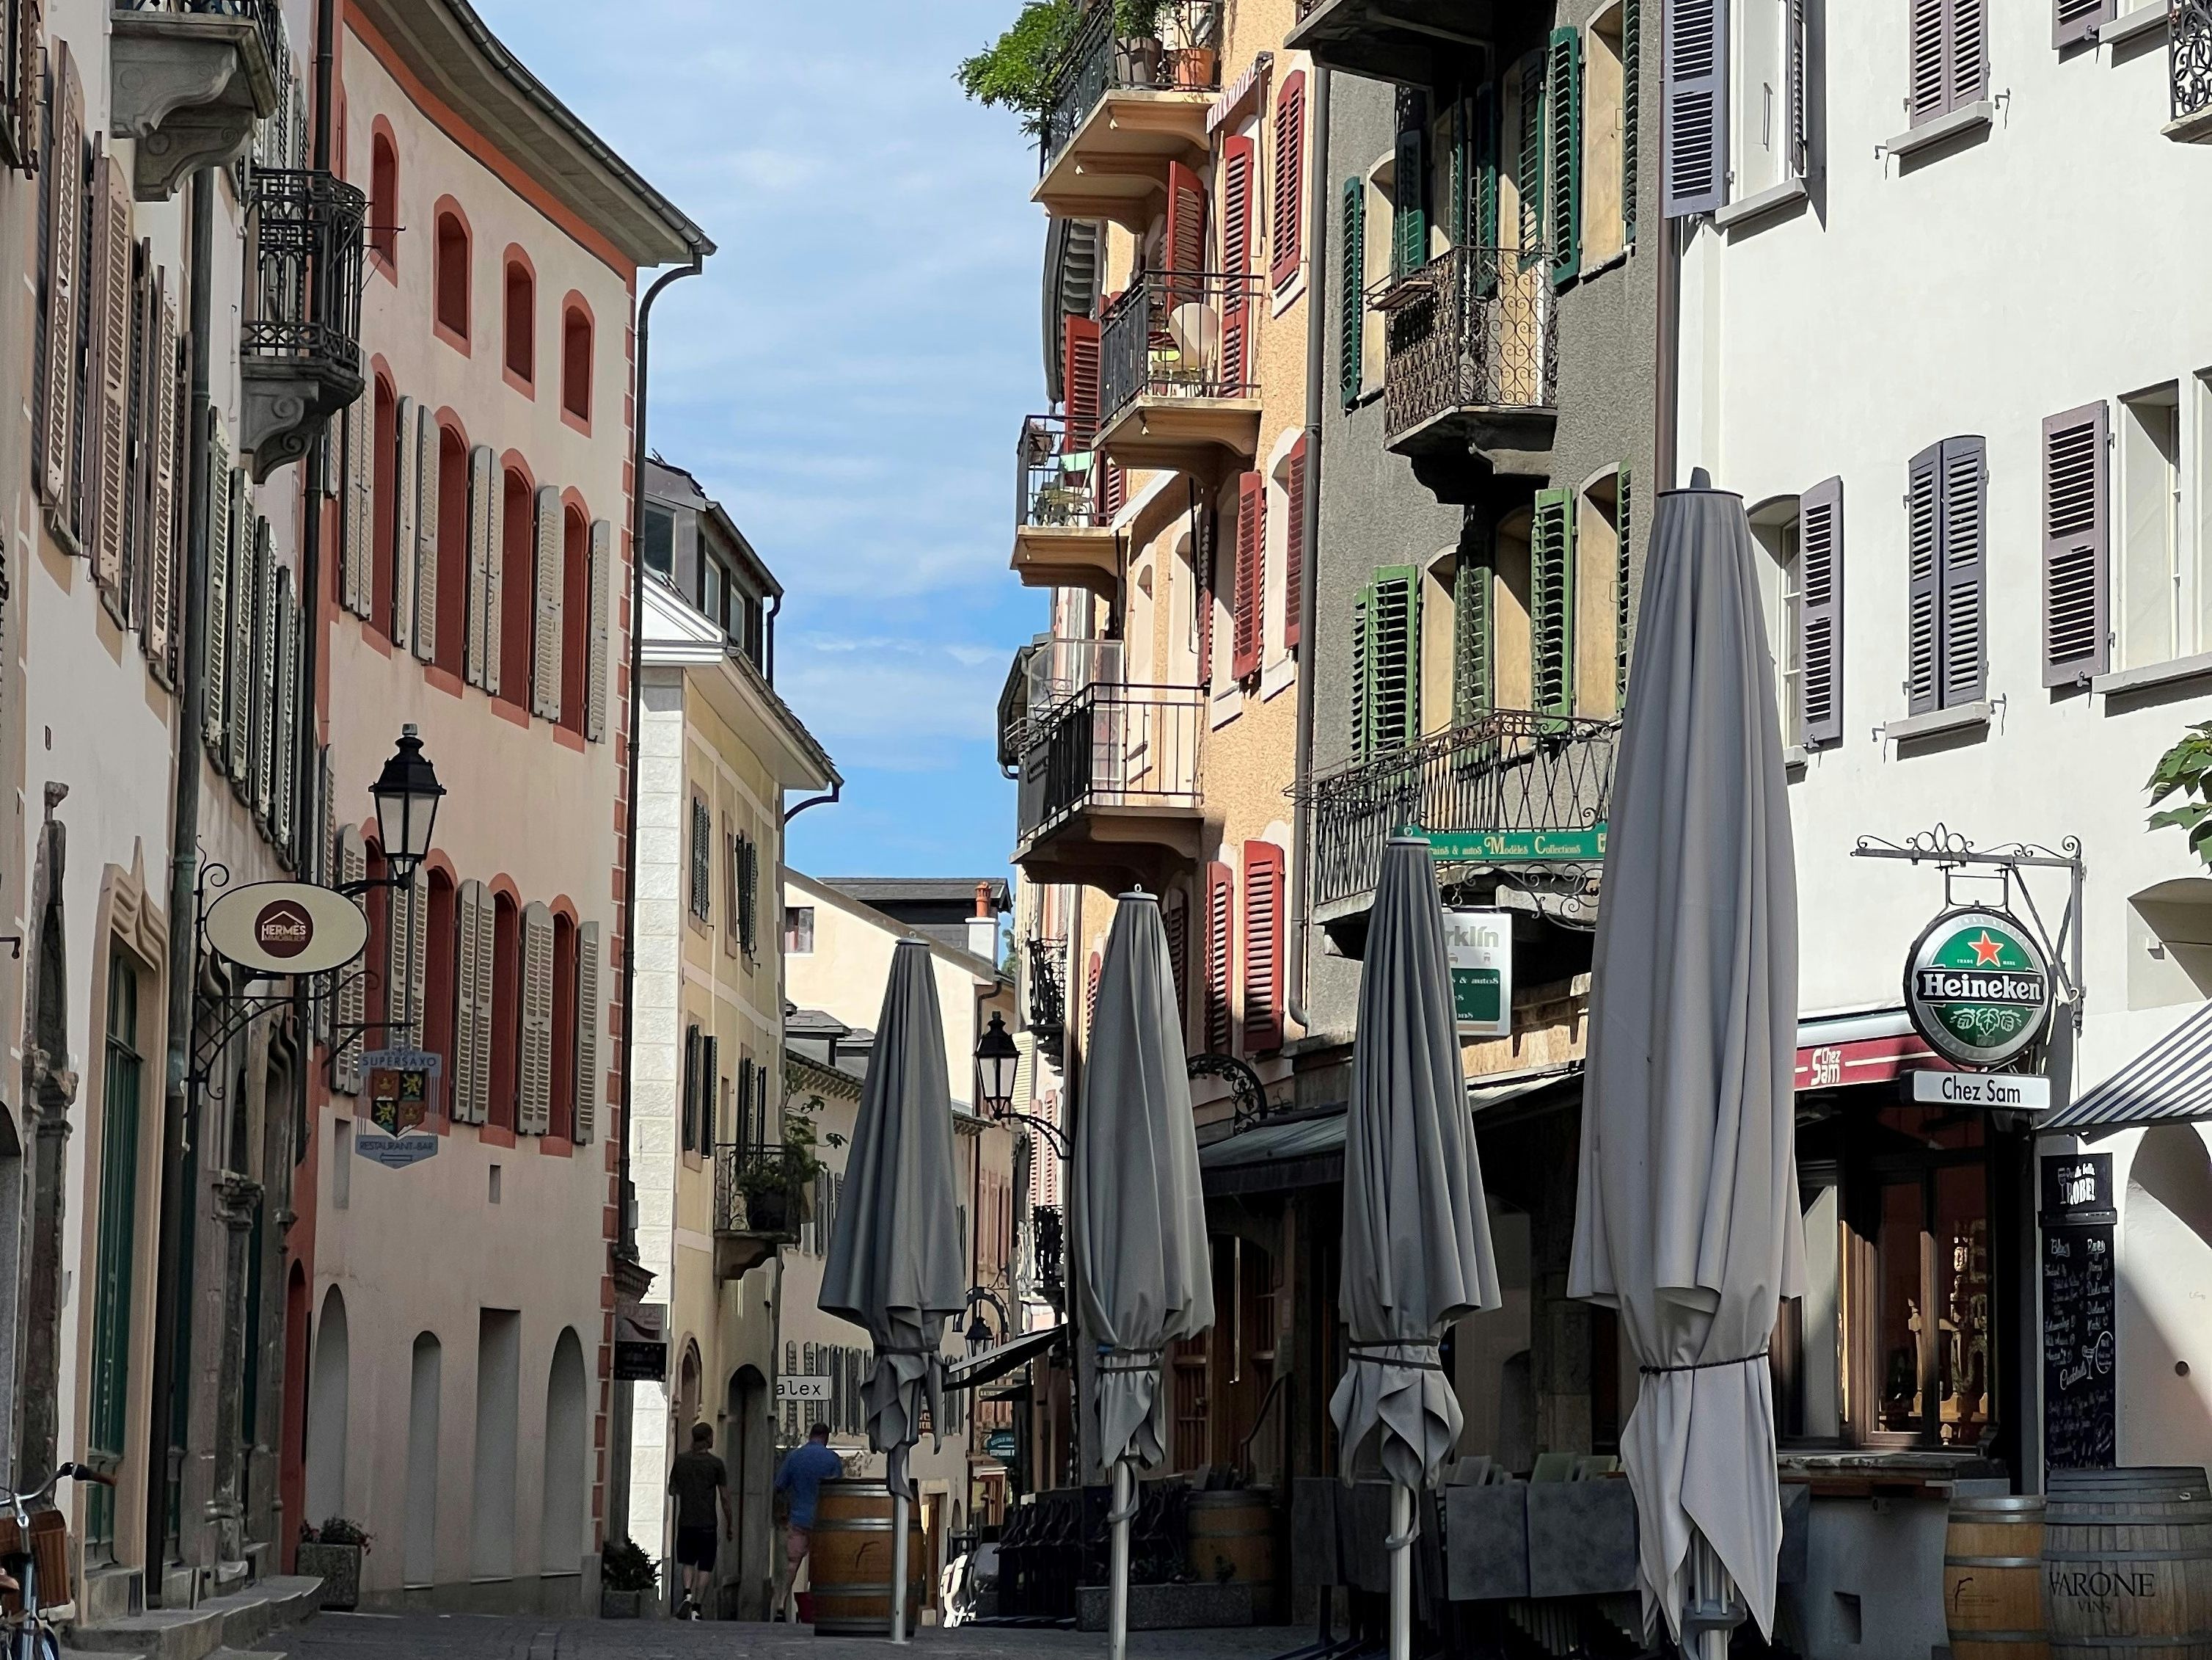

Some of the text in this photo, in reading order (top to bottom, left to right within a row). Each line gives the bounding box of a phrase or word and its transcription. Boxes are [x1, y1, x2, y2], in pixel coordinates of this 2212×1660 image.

[1453, 845, 1458, 856] &
[1923, 973, 2042, 1000] Heineken
[362, 1057, 437, 1066] SUPERSAXO
[1822, 1047, 1841, 1064] Chez
[1811, 1048, 1840, 1086] Sam
[1941, 1075, 2021, 1103] Chez Sam
[776, 1380, 821, 1395] alex
[2049, 1572, 2156, 1597] VARONE
[2078, 1601, 2111, 1615] VINS
